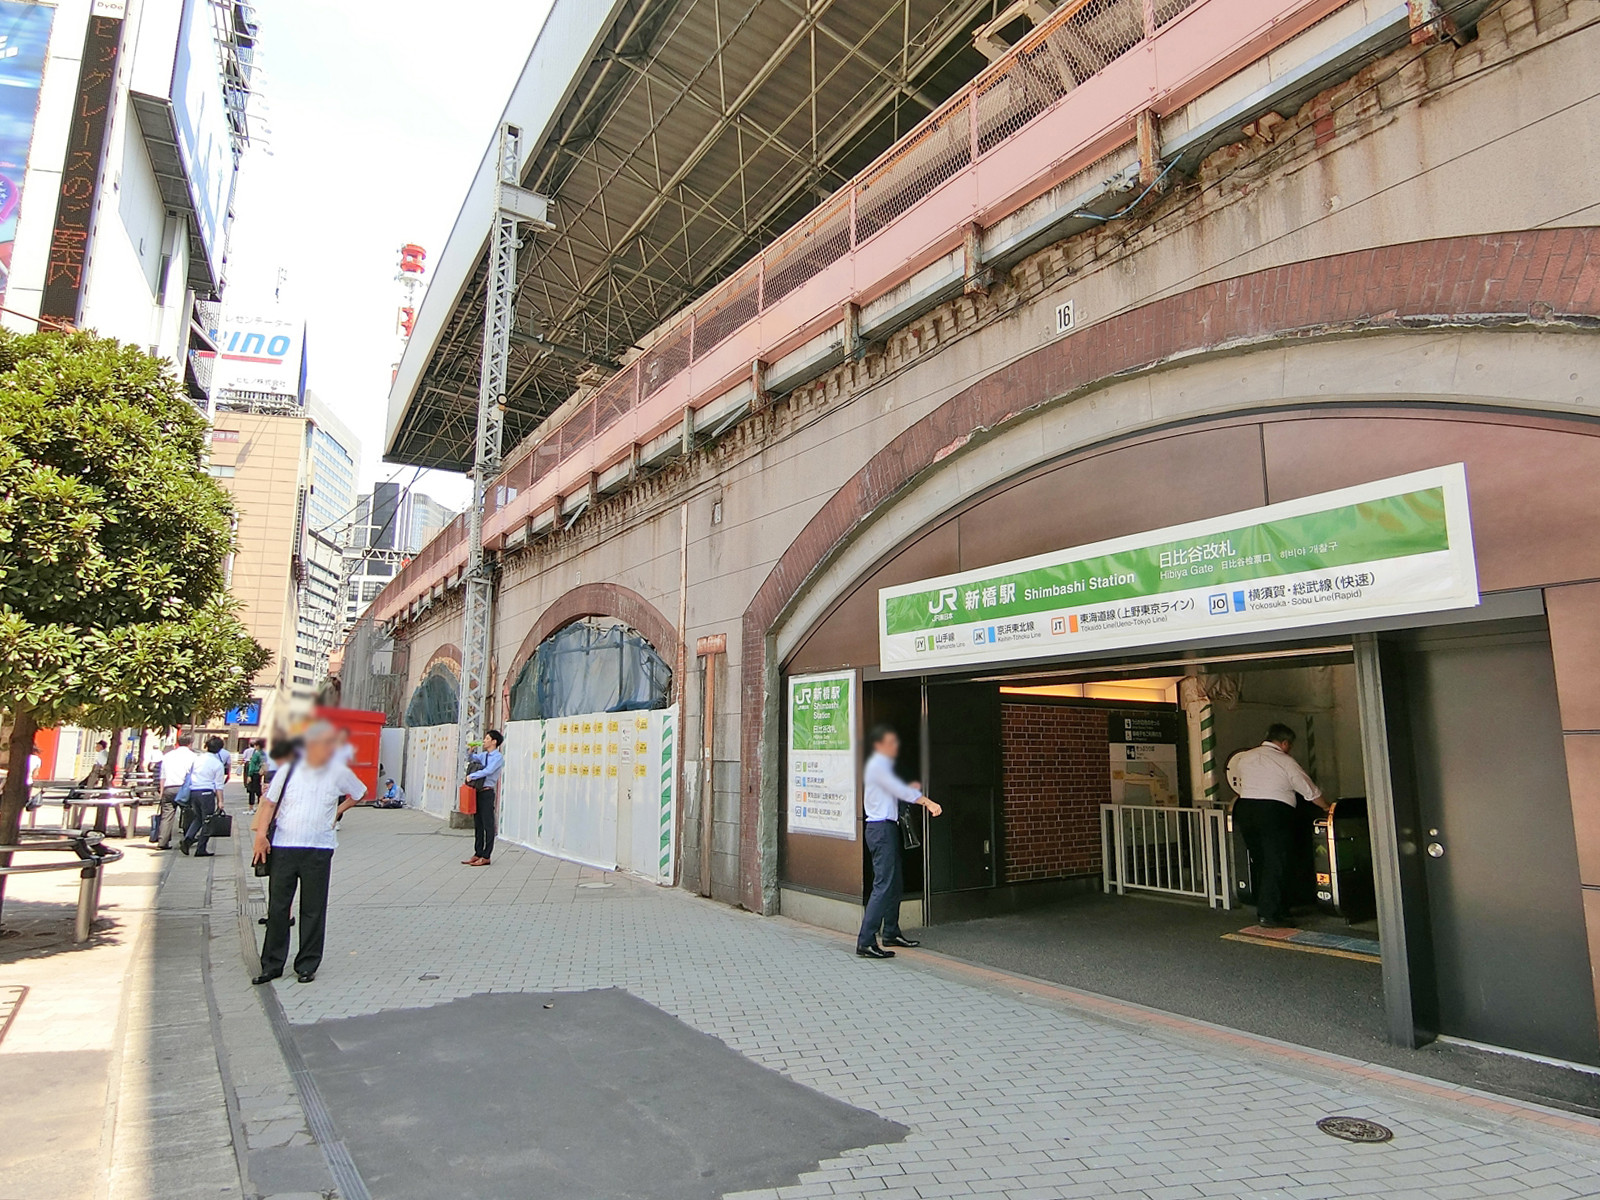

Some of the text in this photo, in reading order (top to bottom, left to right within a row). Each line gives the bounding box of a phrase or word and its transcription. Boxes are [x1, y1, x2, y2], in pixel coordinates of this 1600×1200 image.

[97, 2, 124, 10] DyDo
[1058, 305, 1070, 329] 16
[1159, 539, 1236, 569] 日比谷改札
[1159, 570, 1188, 580] Hibiya
[1190, 564, 1214, 575] Gate
[928, 572, 1135, 614] JR 新橋駅 Shimbashi Station
[1212, 599, 1226, 610] JO
[997, 622, 1035, 636] 京浜東北線
[1054, 621, 1063, 631] JT
[935, 633, 956, 644] 山手線
[975, 632, 984, 641] JK
[916, 641, 925, 649] JY
[796, 688, 812, 704] JR
